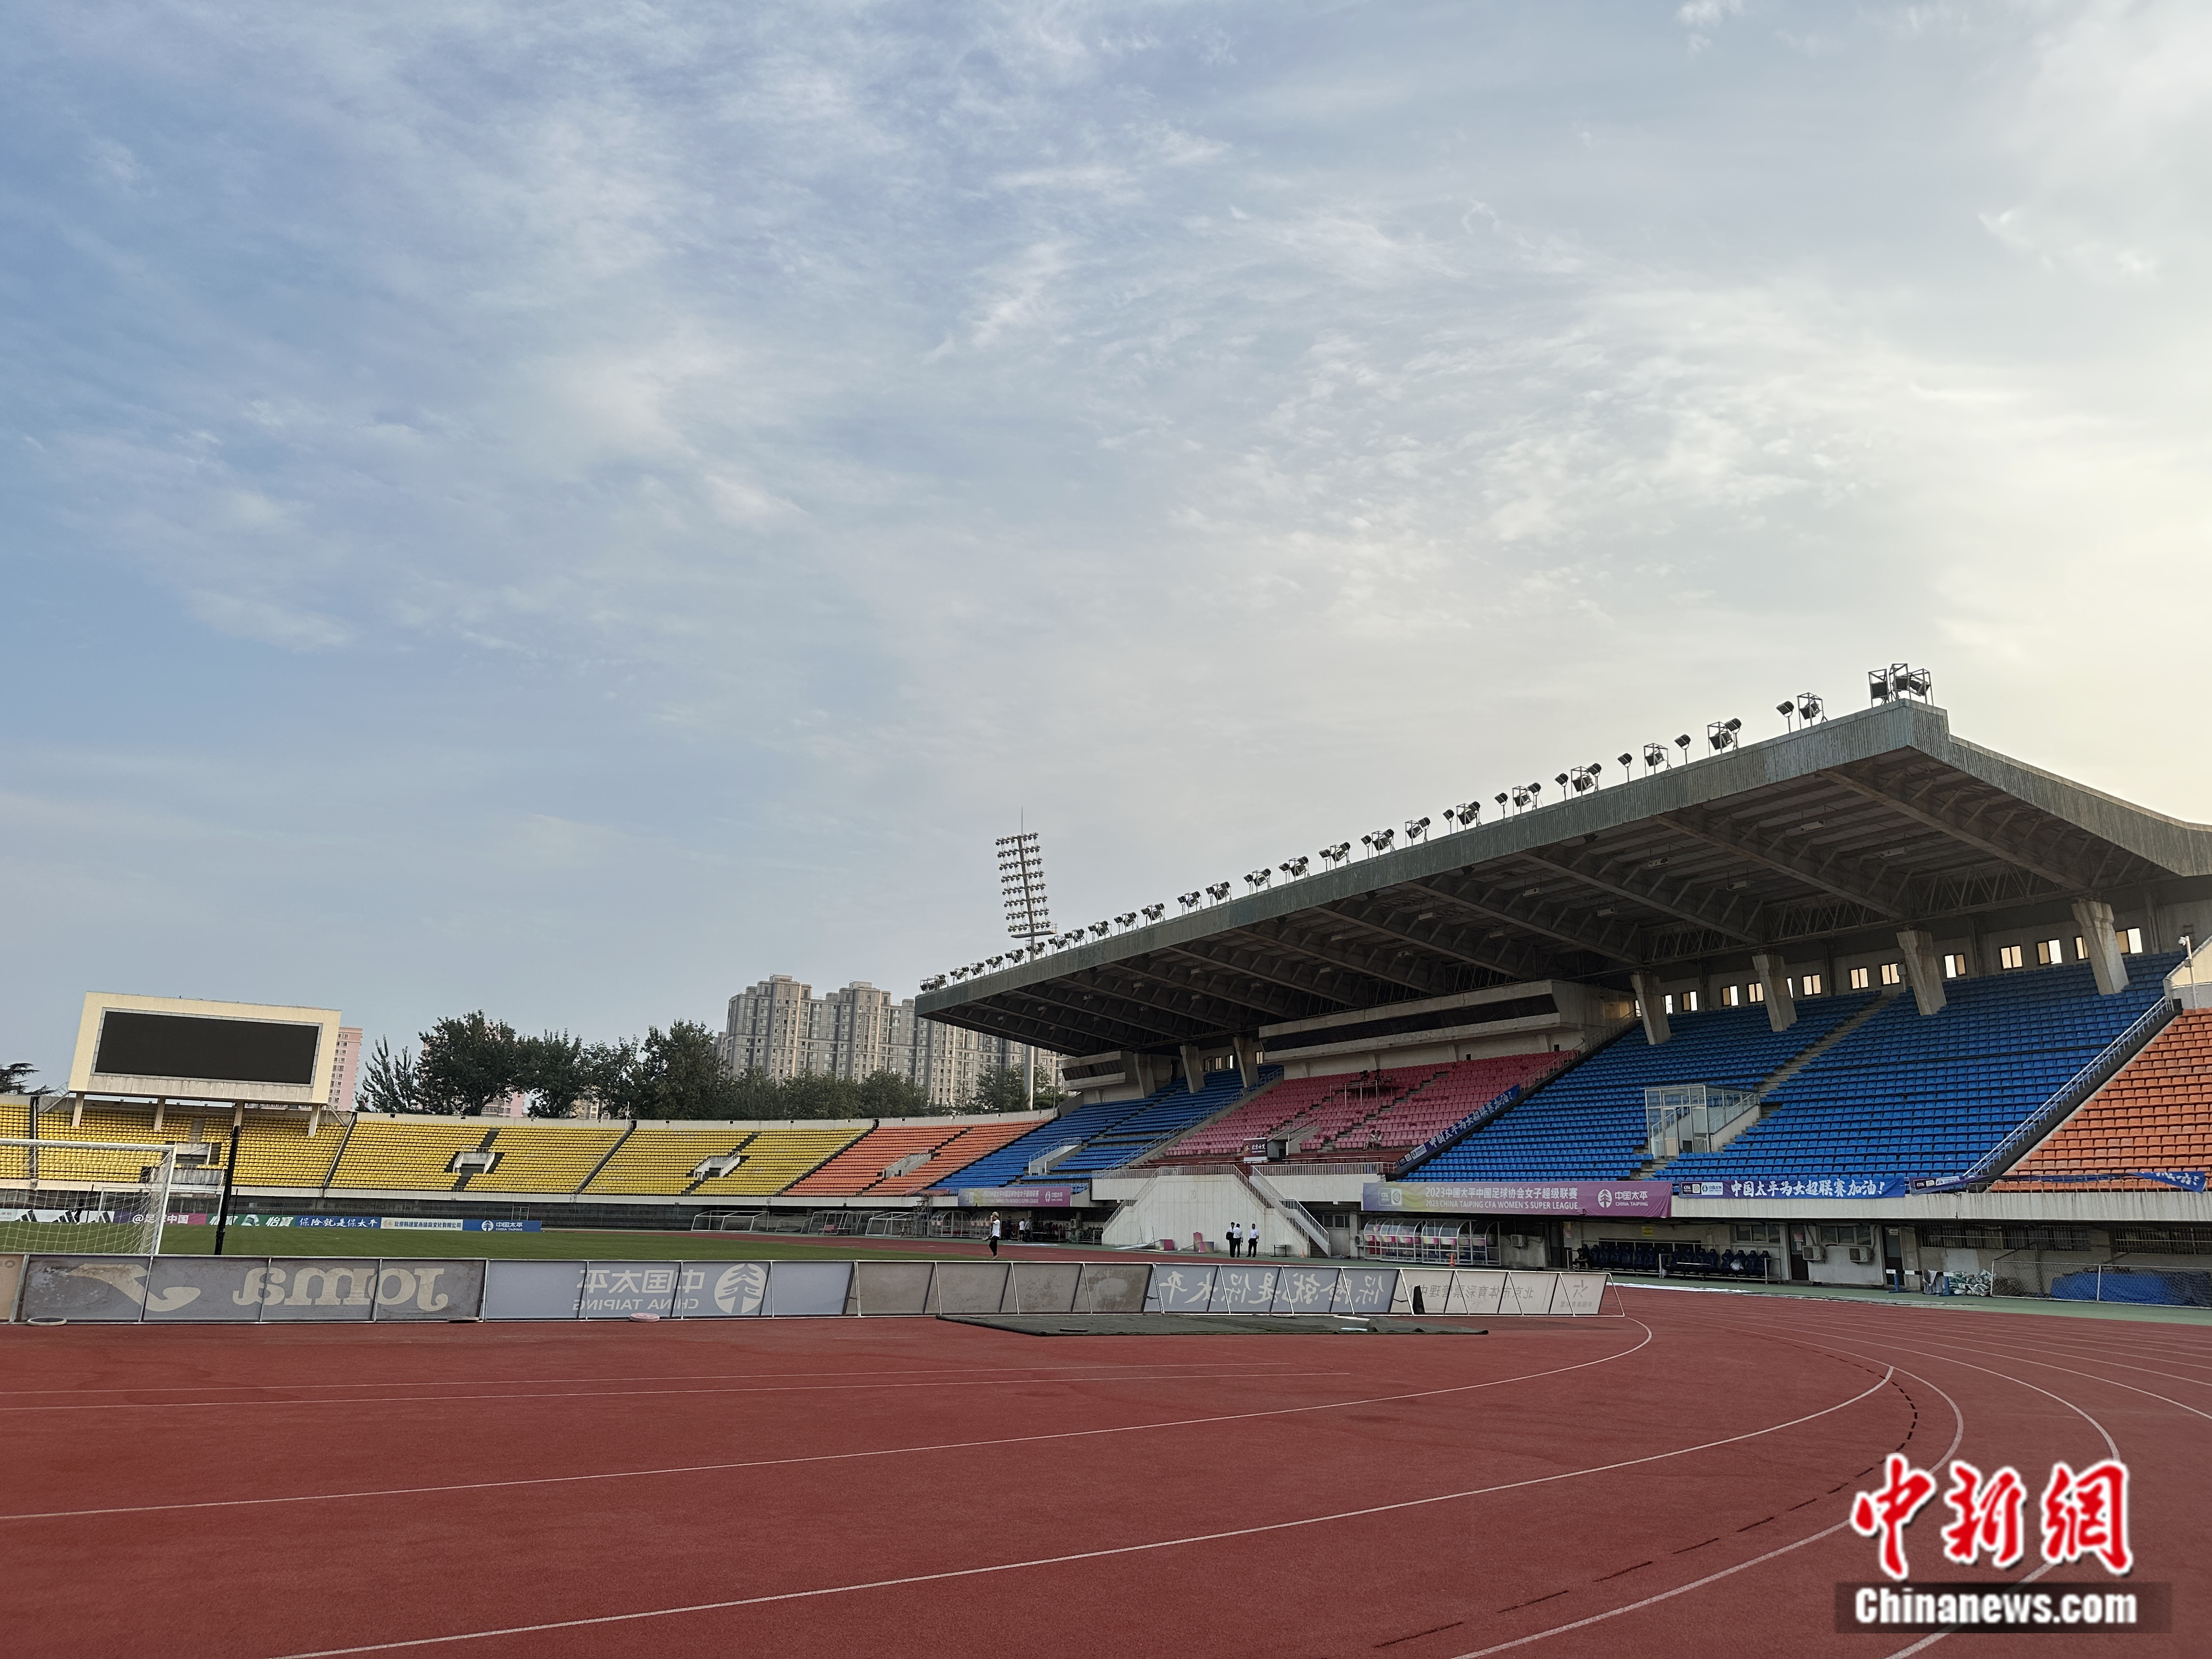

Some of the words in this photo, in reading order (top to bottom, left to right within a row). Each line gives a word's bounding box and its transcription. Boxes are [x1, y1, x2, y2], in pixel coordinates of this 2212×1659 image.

[1615, 1191, 1648, 1200] 中国太平
[1498, 1201, 1528, 1209] WOMEN'S
[1553, 1201, 1578, 1210] LEAGUE
[132, 1214, 189, 1224] @足中国
[299, 1217, 378, 1228] 保险就是保太平
